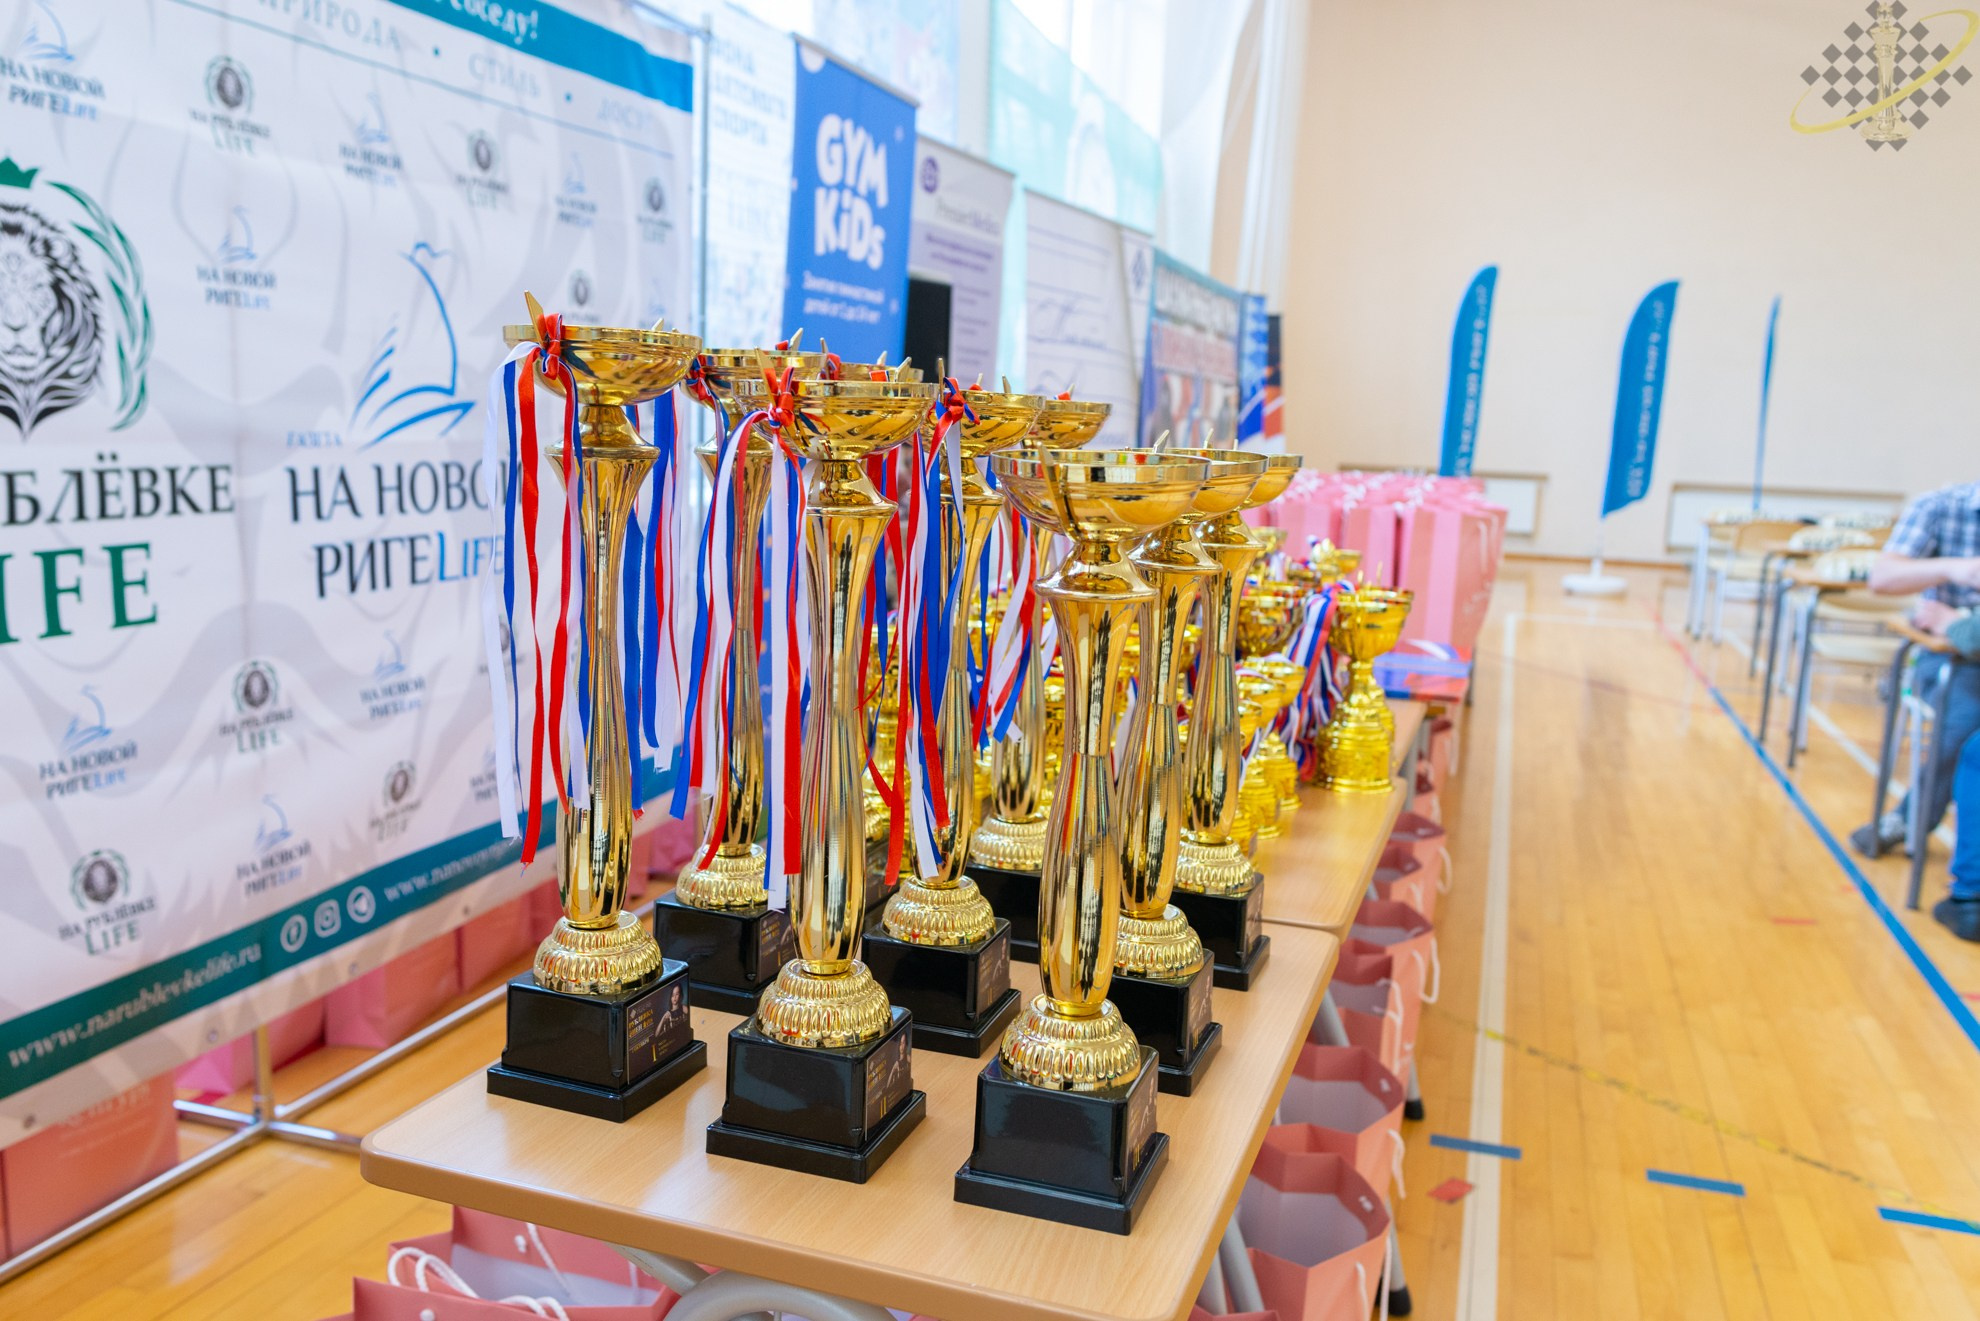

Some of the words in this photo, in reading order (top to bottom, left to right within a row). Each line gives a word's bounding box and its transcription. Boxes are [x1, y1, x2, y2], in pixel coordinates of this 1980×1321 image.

[815, 113, 889, 209] GYM
[285, 466, 363, 523] НА
[83, 920, 142, 957] LIFE
